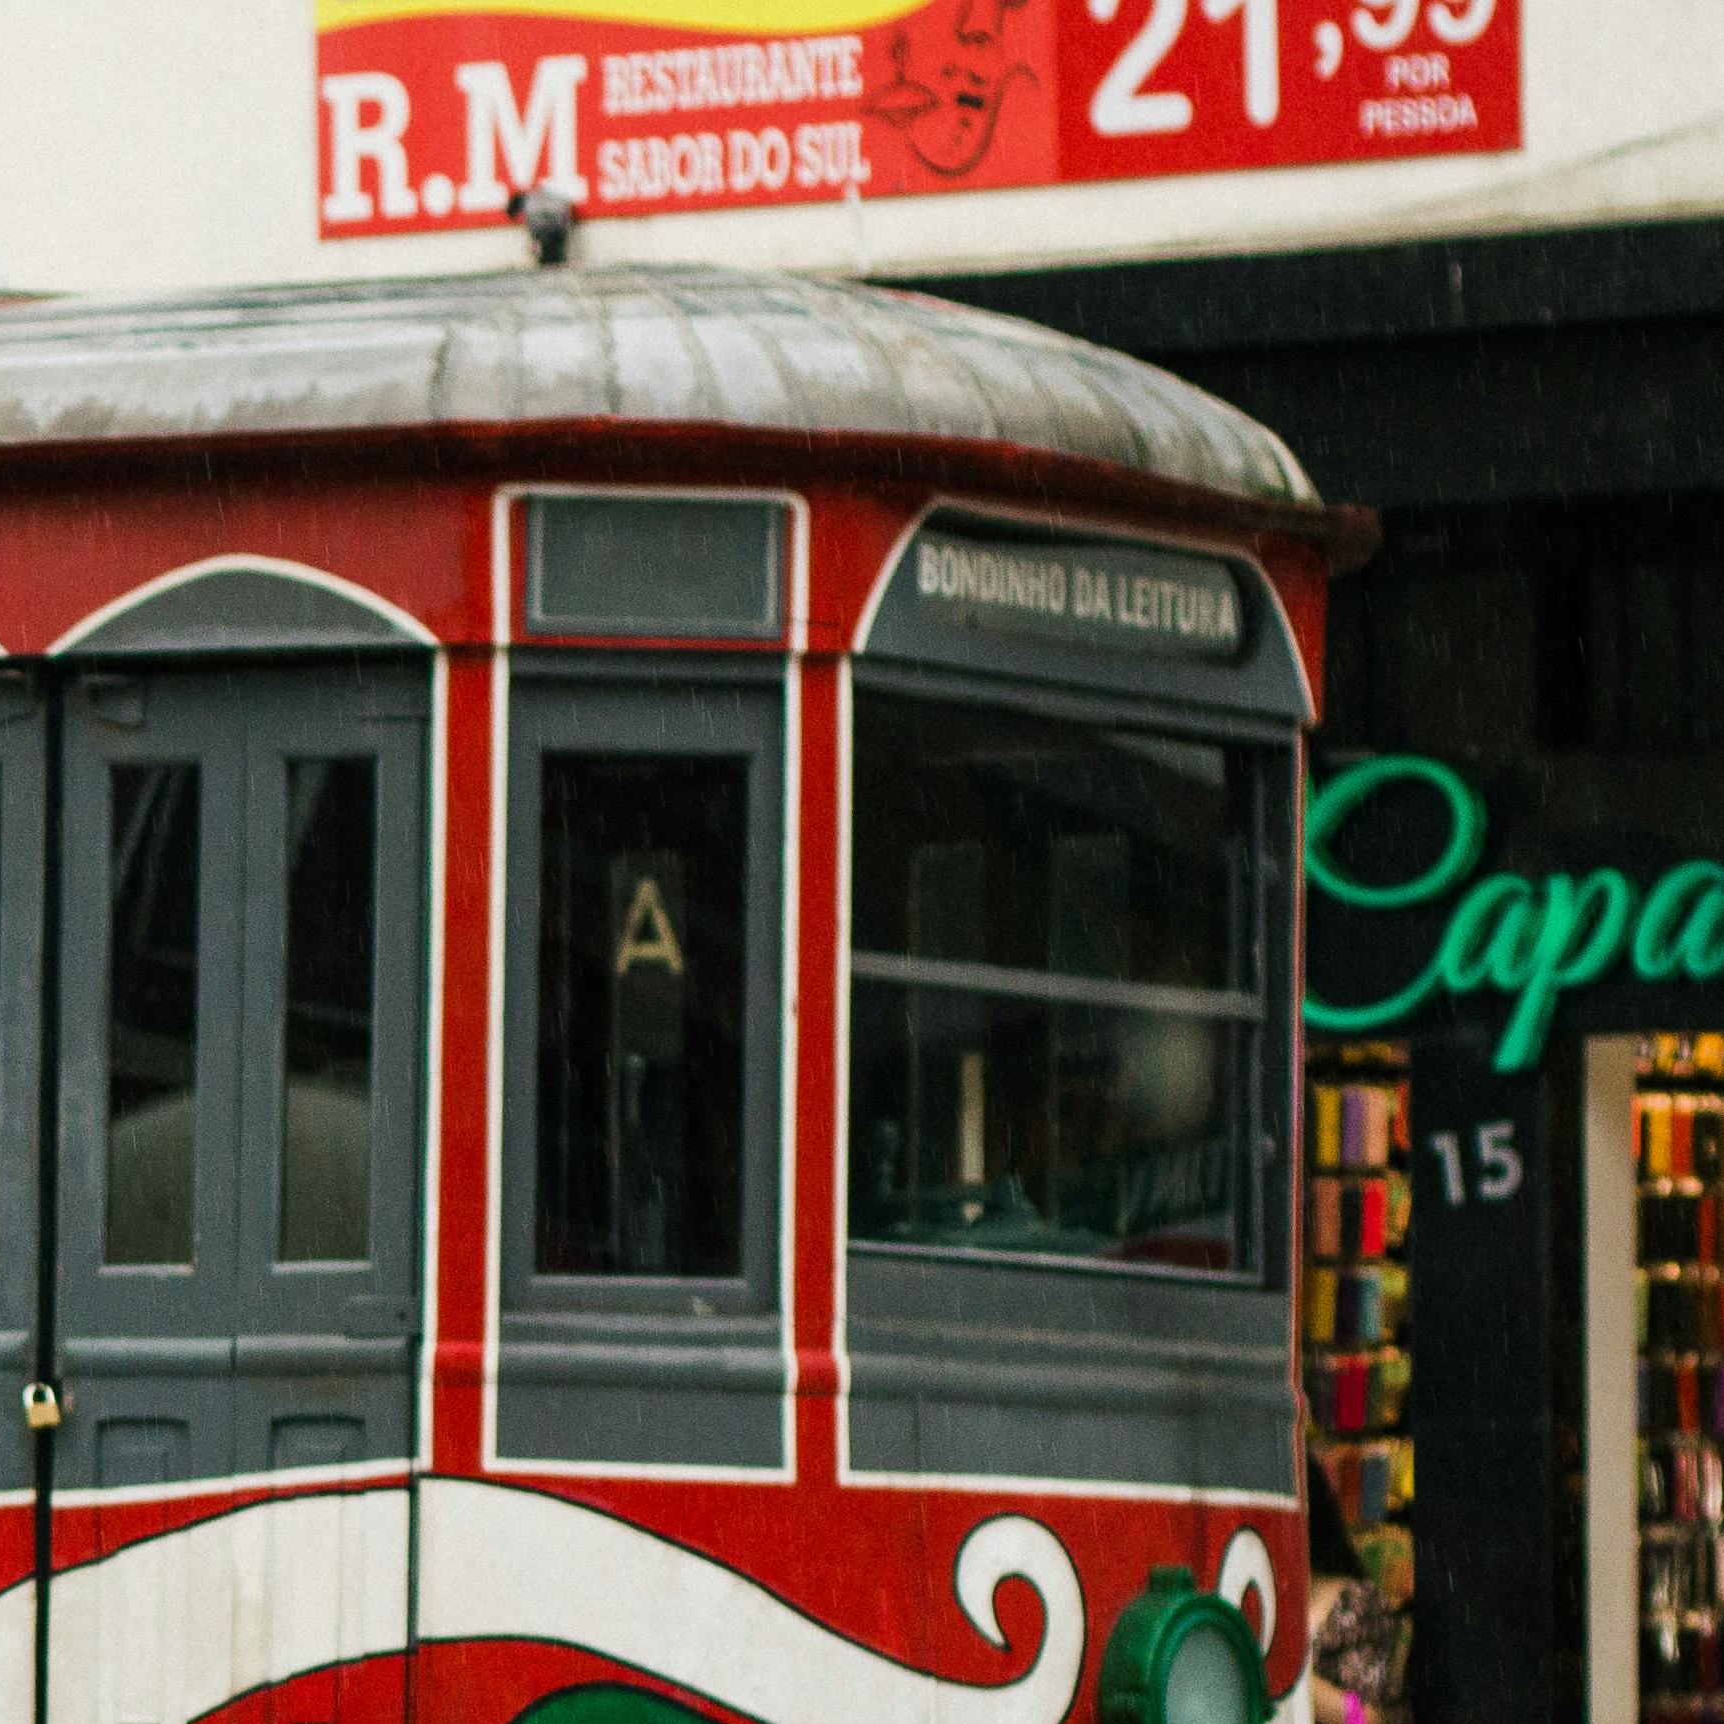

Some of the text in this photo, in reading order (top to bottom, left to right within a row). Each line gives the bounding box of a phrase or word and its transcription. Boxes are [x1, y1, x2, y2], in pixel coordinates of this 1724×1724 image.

[602, 35, 863, 116] RESTAURANTE
[1387, 52, 1451, 90] POR
[322, 55, 588, 222] R.M
[1360, 94, 1479, 138] PESSOA
[598, 121, 871, 201] SABOR DO SUL
[917, 542, 1239, 640] BONDINHO DA LEITURA
[1429, 1120, 1524, 1206] 15
